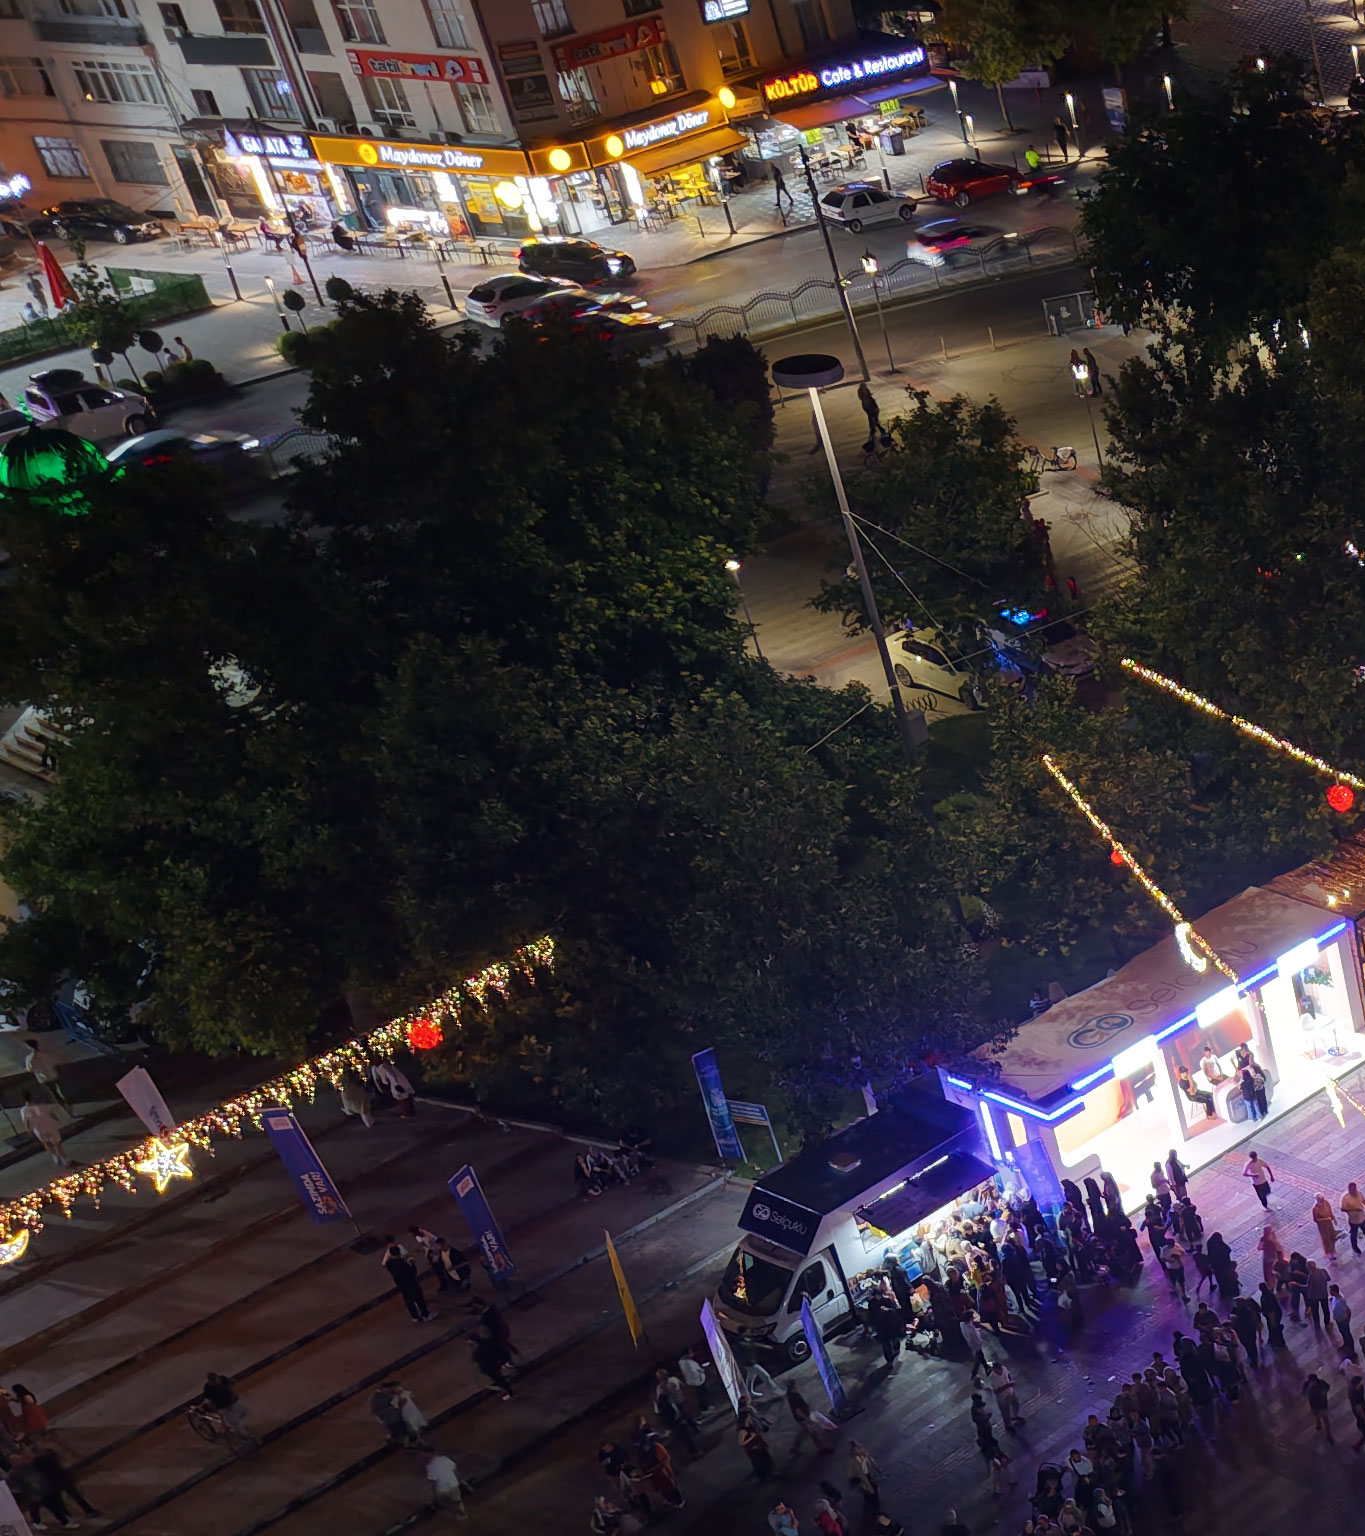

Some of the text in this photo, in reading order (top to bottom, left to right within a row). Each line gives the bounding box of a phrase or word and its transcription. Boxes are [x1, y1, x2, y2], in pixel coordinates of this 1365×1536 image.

[765, 47, 924, 100] KÜLTÜR Cafe & Restaurant
[624, 111, 709, 148] Maydonoz Döner
[240, 135, 290, 154] GAATA
[380, 146, 483, 168] Maydonoz Döner
[771, 1210, 808, 1235] Selçuklu
